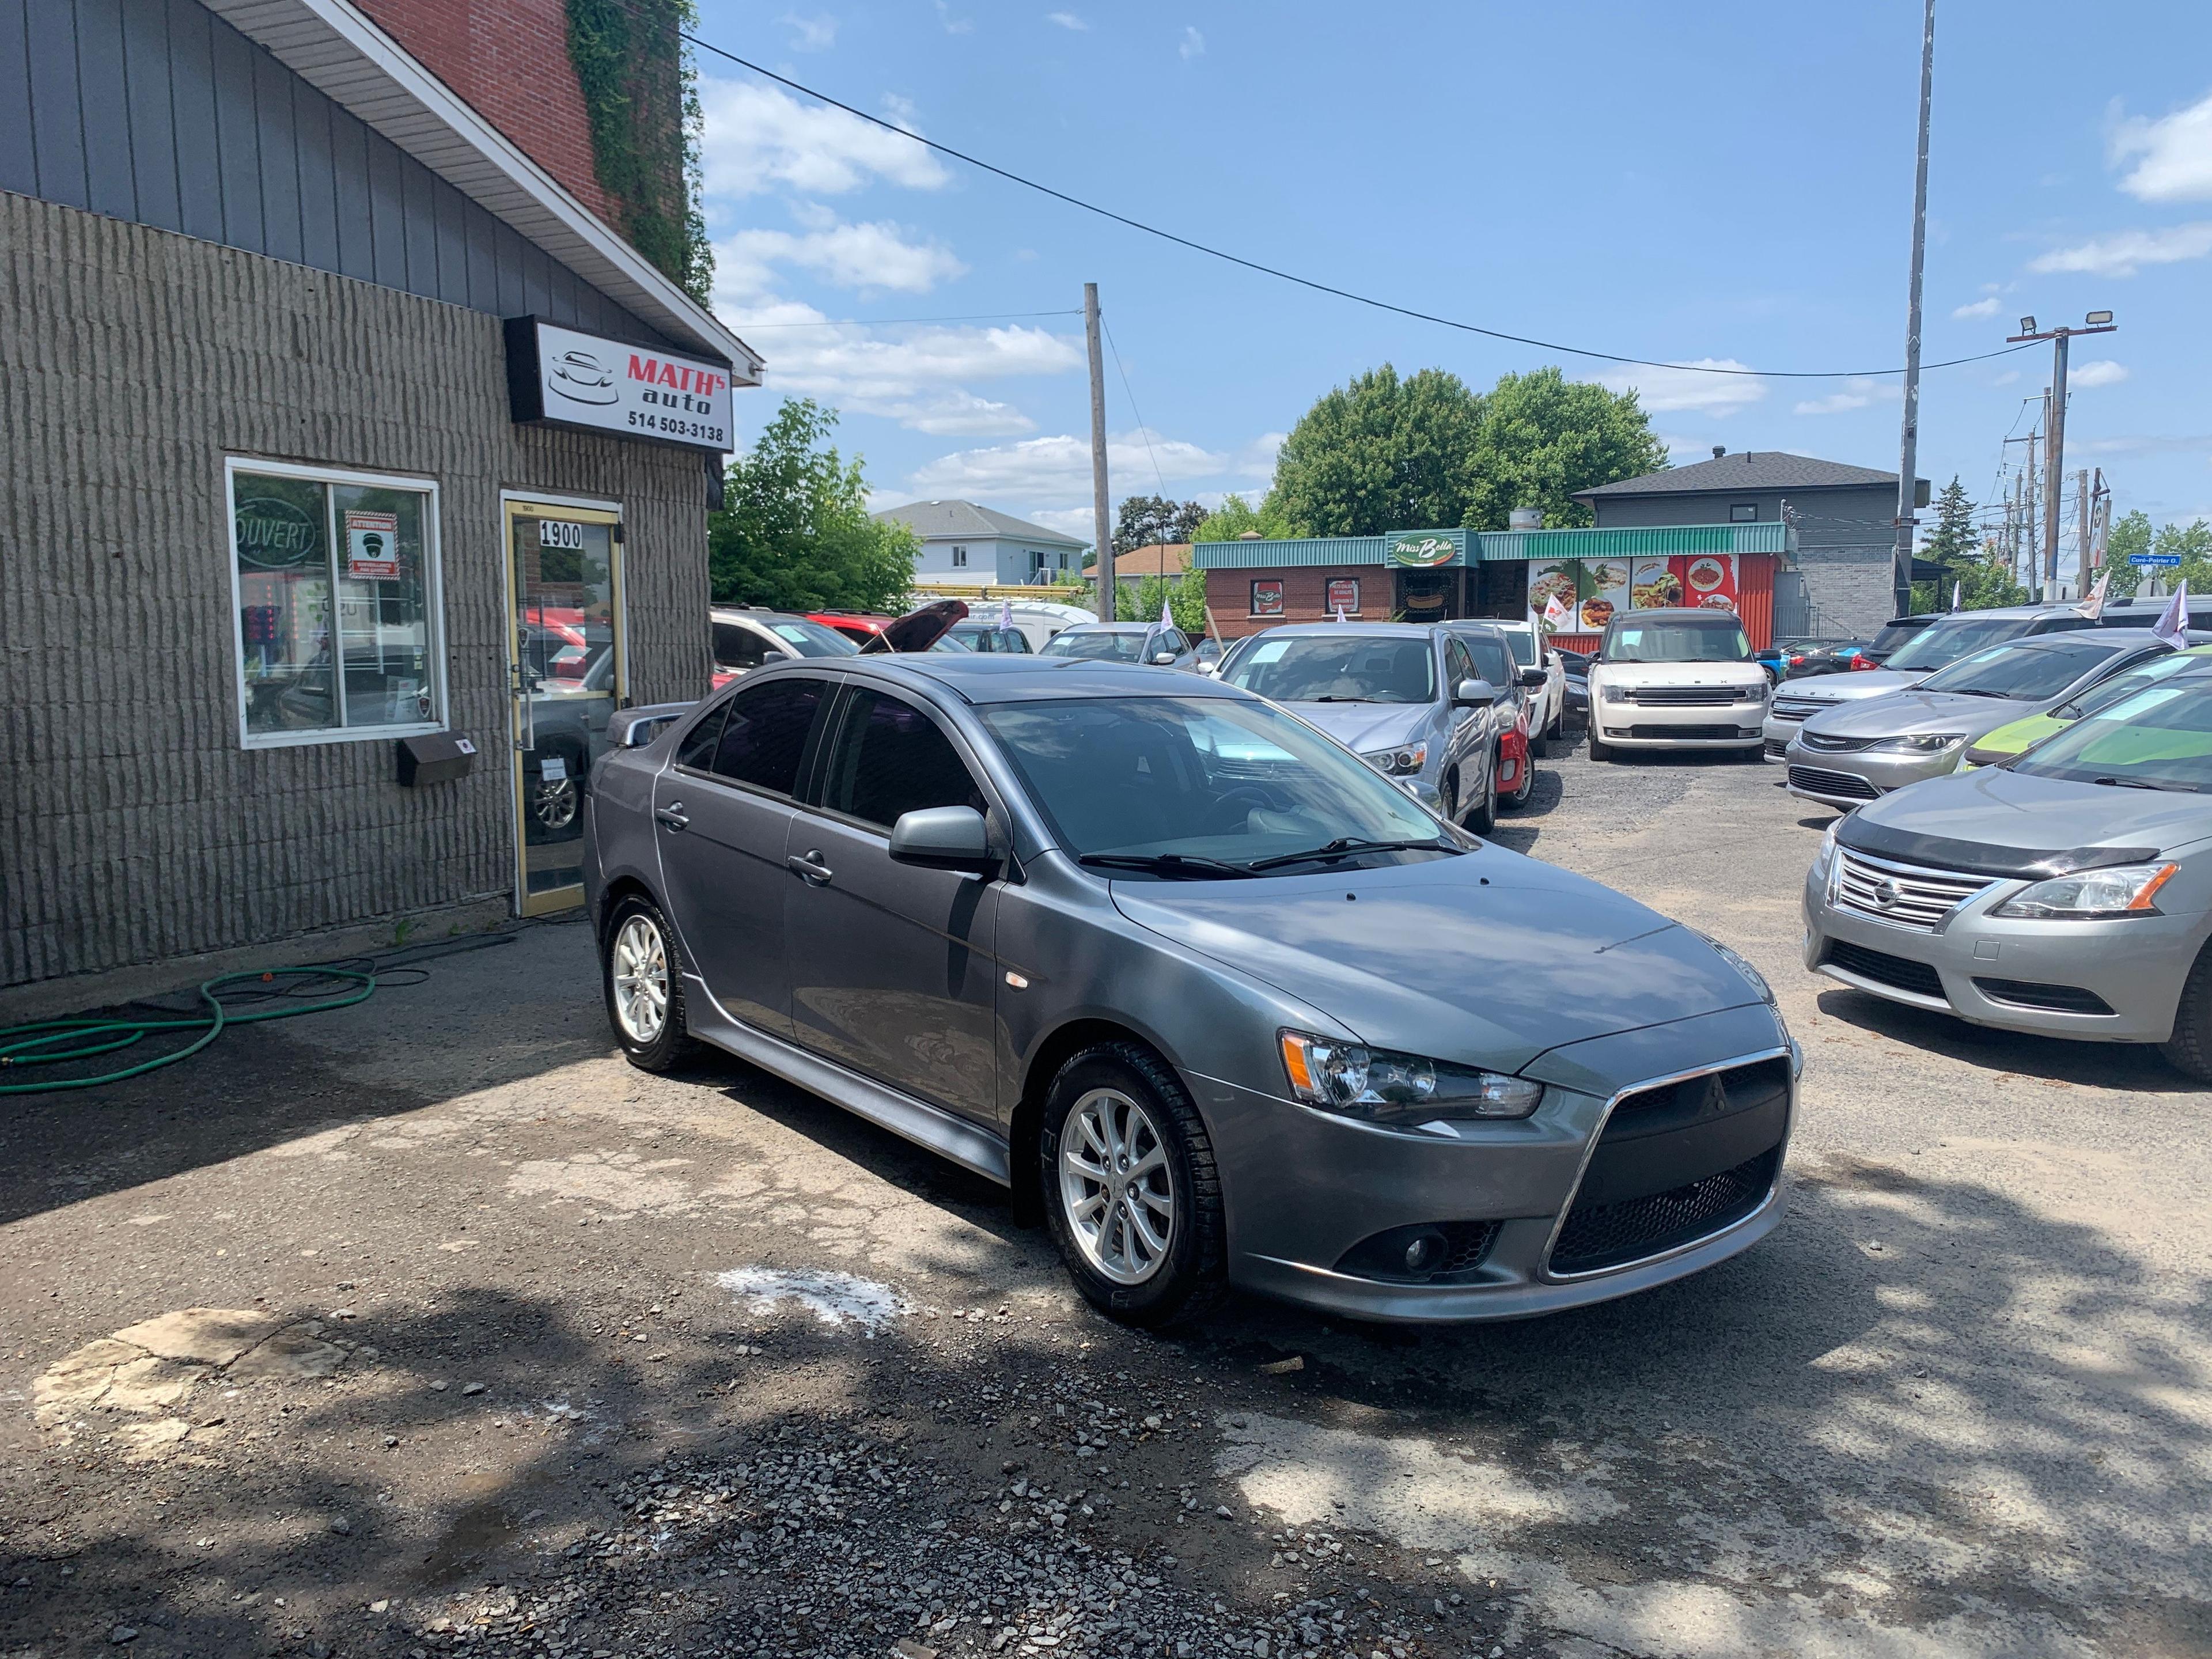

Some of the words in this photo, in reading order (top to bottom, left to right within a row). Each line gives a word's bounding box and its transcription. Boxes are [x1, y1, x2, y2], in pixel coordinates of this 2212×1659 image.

[642, 388, 711, 415] auto
[628, 411, 656, 430] 514
[660, 419, 724, 442] 503-3138
[236, 518, 309, 550] OUVERT
[352, 520, 392, 529] ATTENTION
[541, 521, 581, 548] 1900
[1395, 542, 1421, 553] Miss
[1419, 539, 1452, 558] Bella
